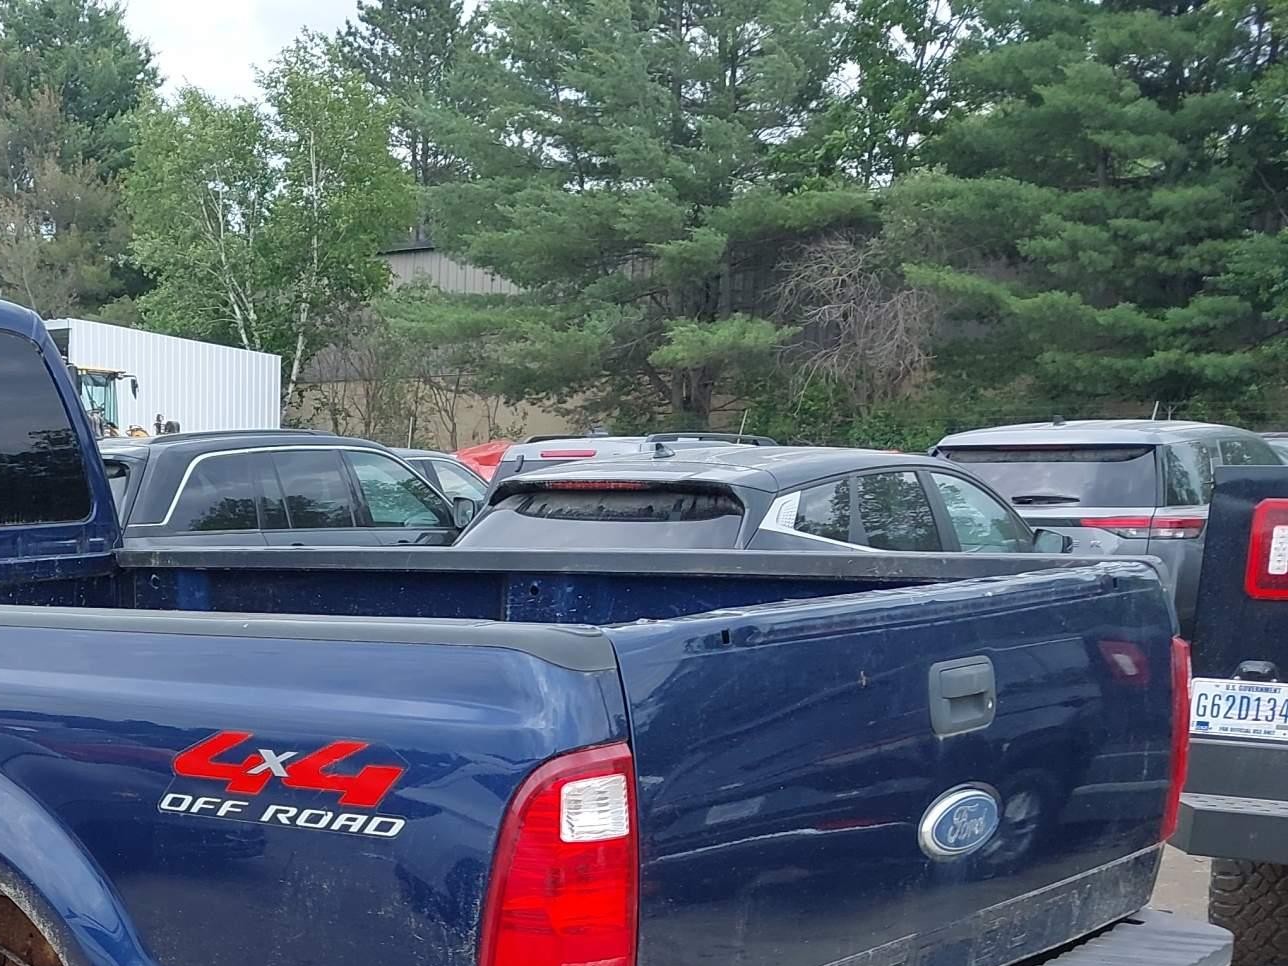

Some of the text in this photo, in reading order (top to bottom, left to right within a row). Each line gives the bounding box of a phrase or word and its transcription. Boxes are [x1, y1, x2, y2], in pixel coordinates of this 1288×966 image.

[1196, 693, 1288, 724] G62D134
[159, 793, 406, 838] OFF ROAD
[947, 803, 989, 844] Ford
